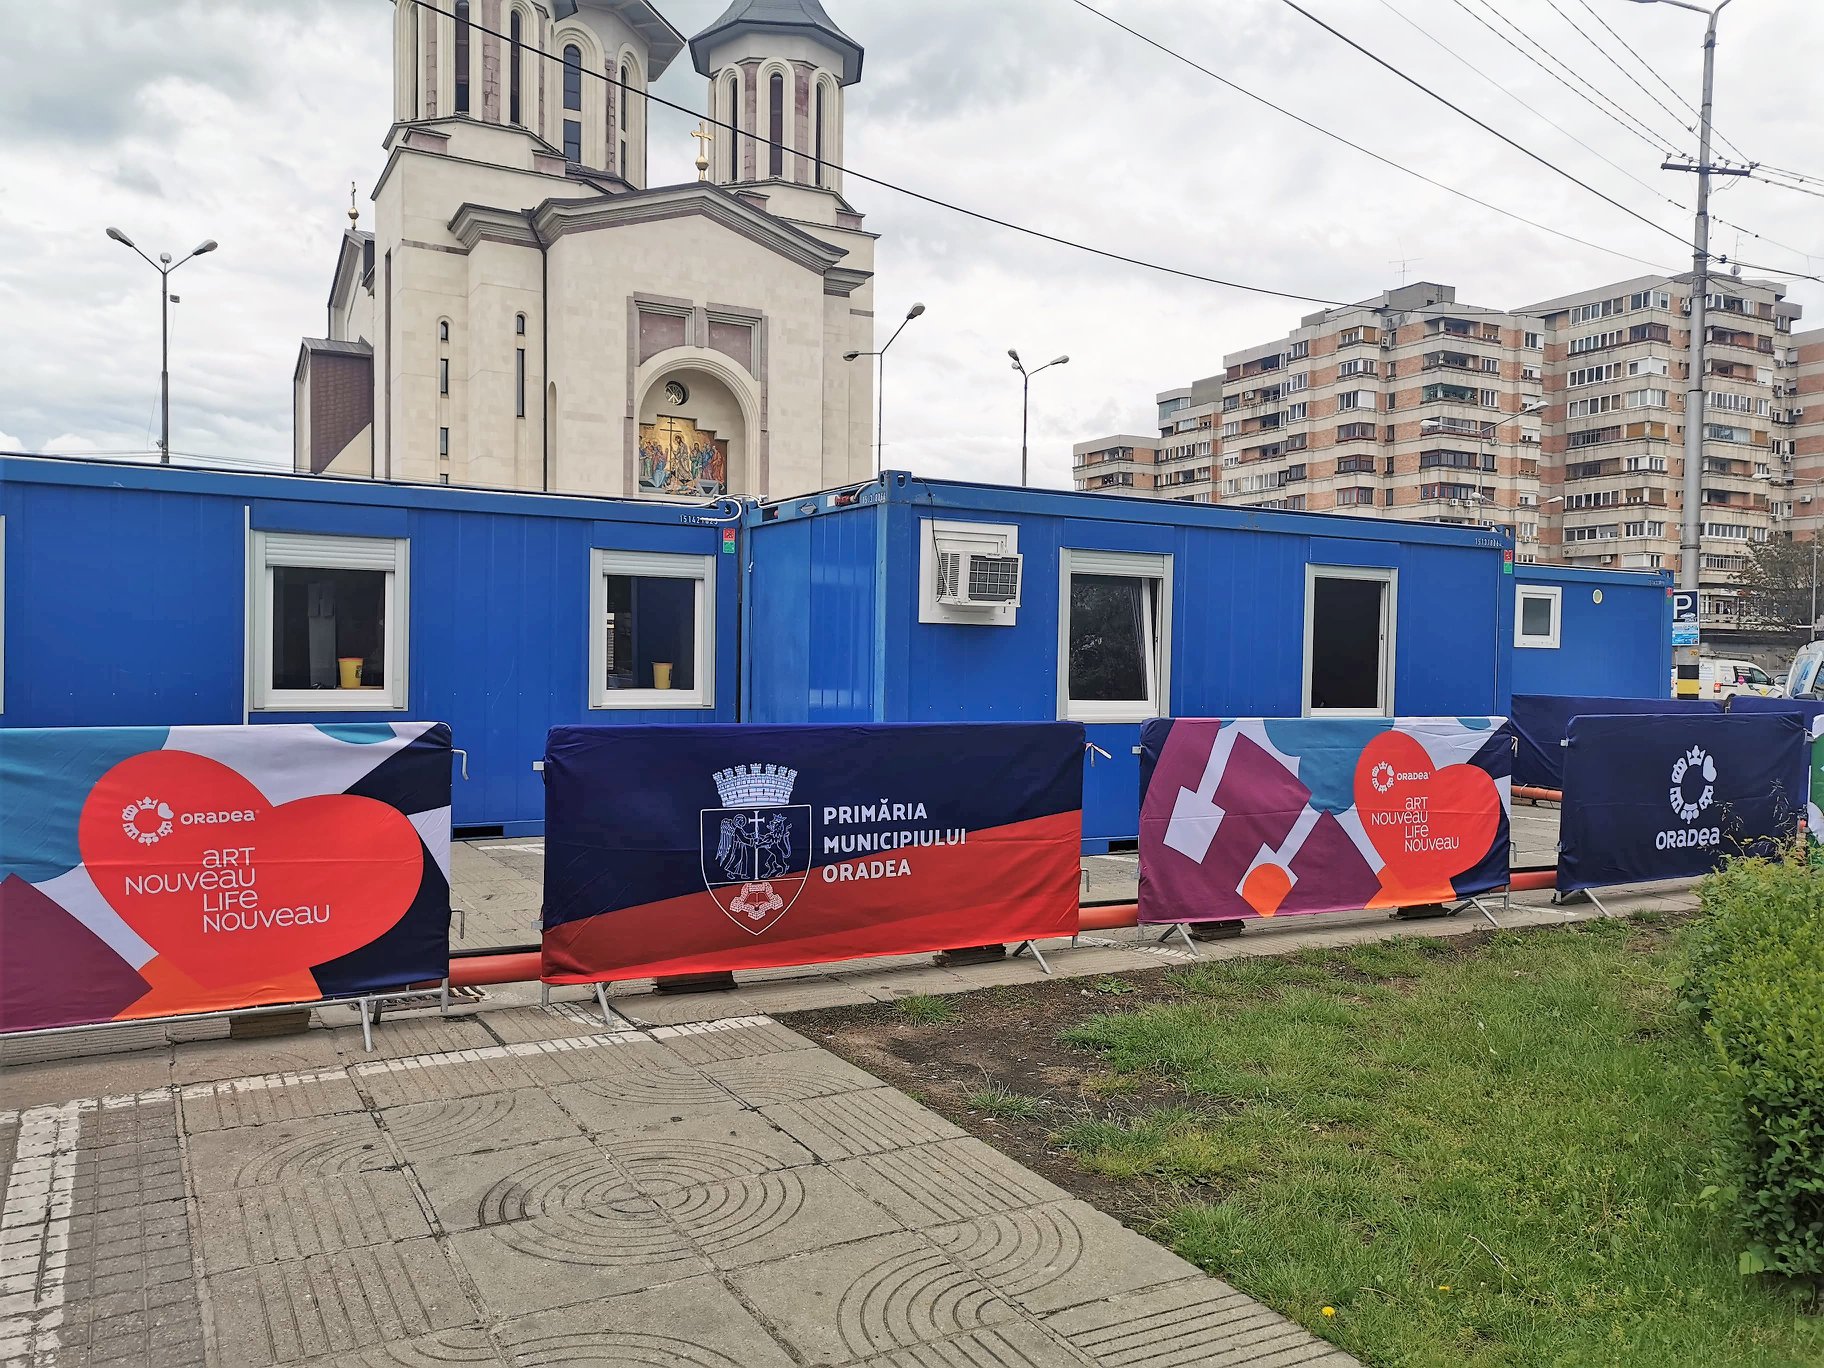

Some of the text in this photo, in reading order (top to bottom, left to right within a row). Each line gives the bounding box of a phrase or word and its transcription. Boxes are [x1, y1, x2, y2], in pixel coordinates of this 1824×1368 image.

[1674, 595, 1693, 620] P
[823, 798, 928, 825] PRIMĂRIA
[823, 828, 967, 854] MUNICIPIULUI
[822, 858, 912, 883] ORADEA
